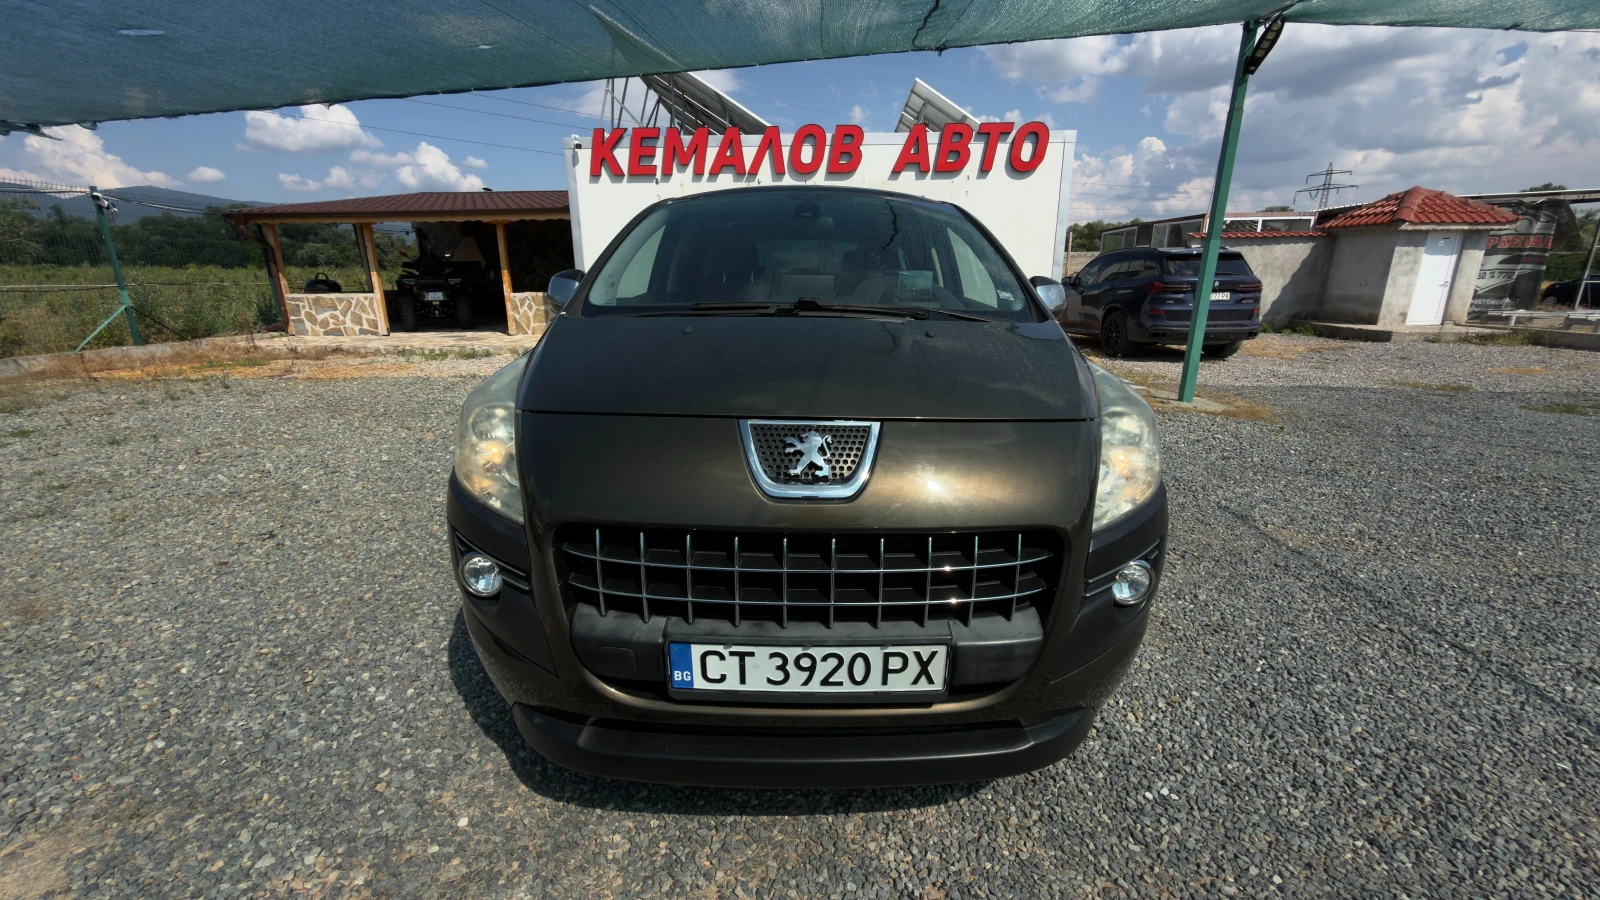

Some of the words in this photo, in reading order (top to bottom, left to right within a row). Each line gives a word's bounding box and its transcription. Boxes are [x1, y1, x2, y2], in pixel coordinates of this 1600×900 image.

[590, 123, 864, 176] КЕМАЛОВ
[892, 121, 1049, 172] АВТО
[674, 671, 692, 682] BG
[700, 650, 756, 685] CT
[766, 651, 872, 687] 3920
[881, 650, 939, 686] PX
